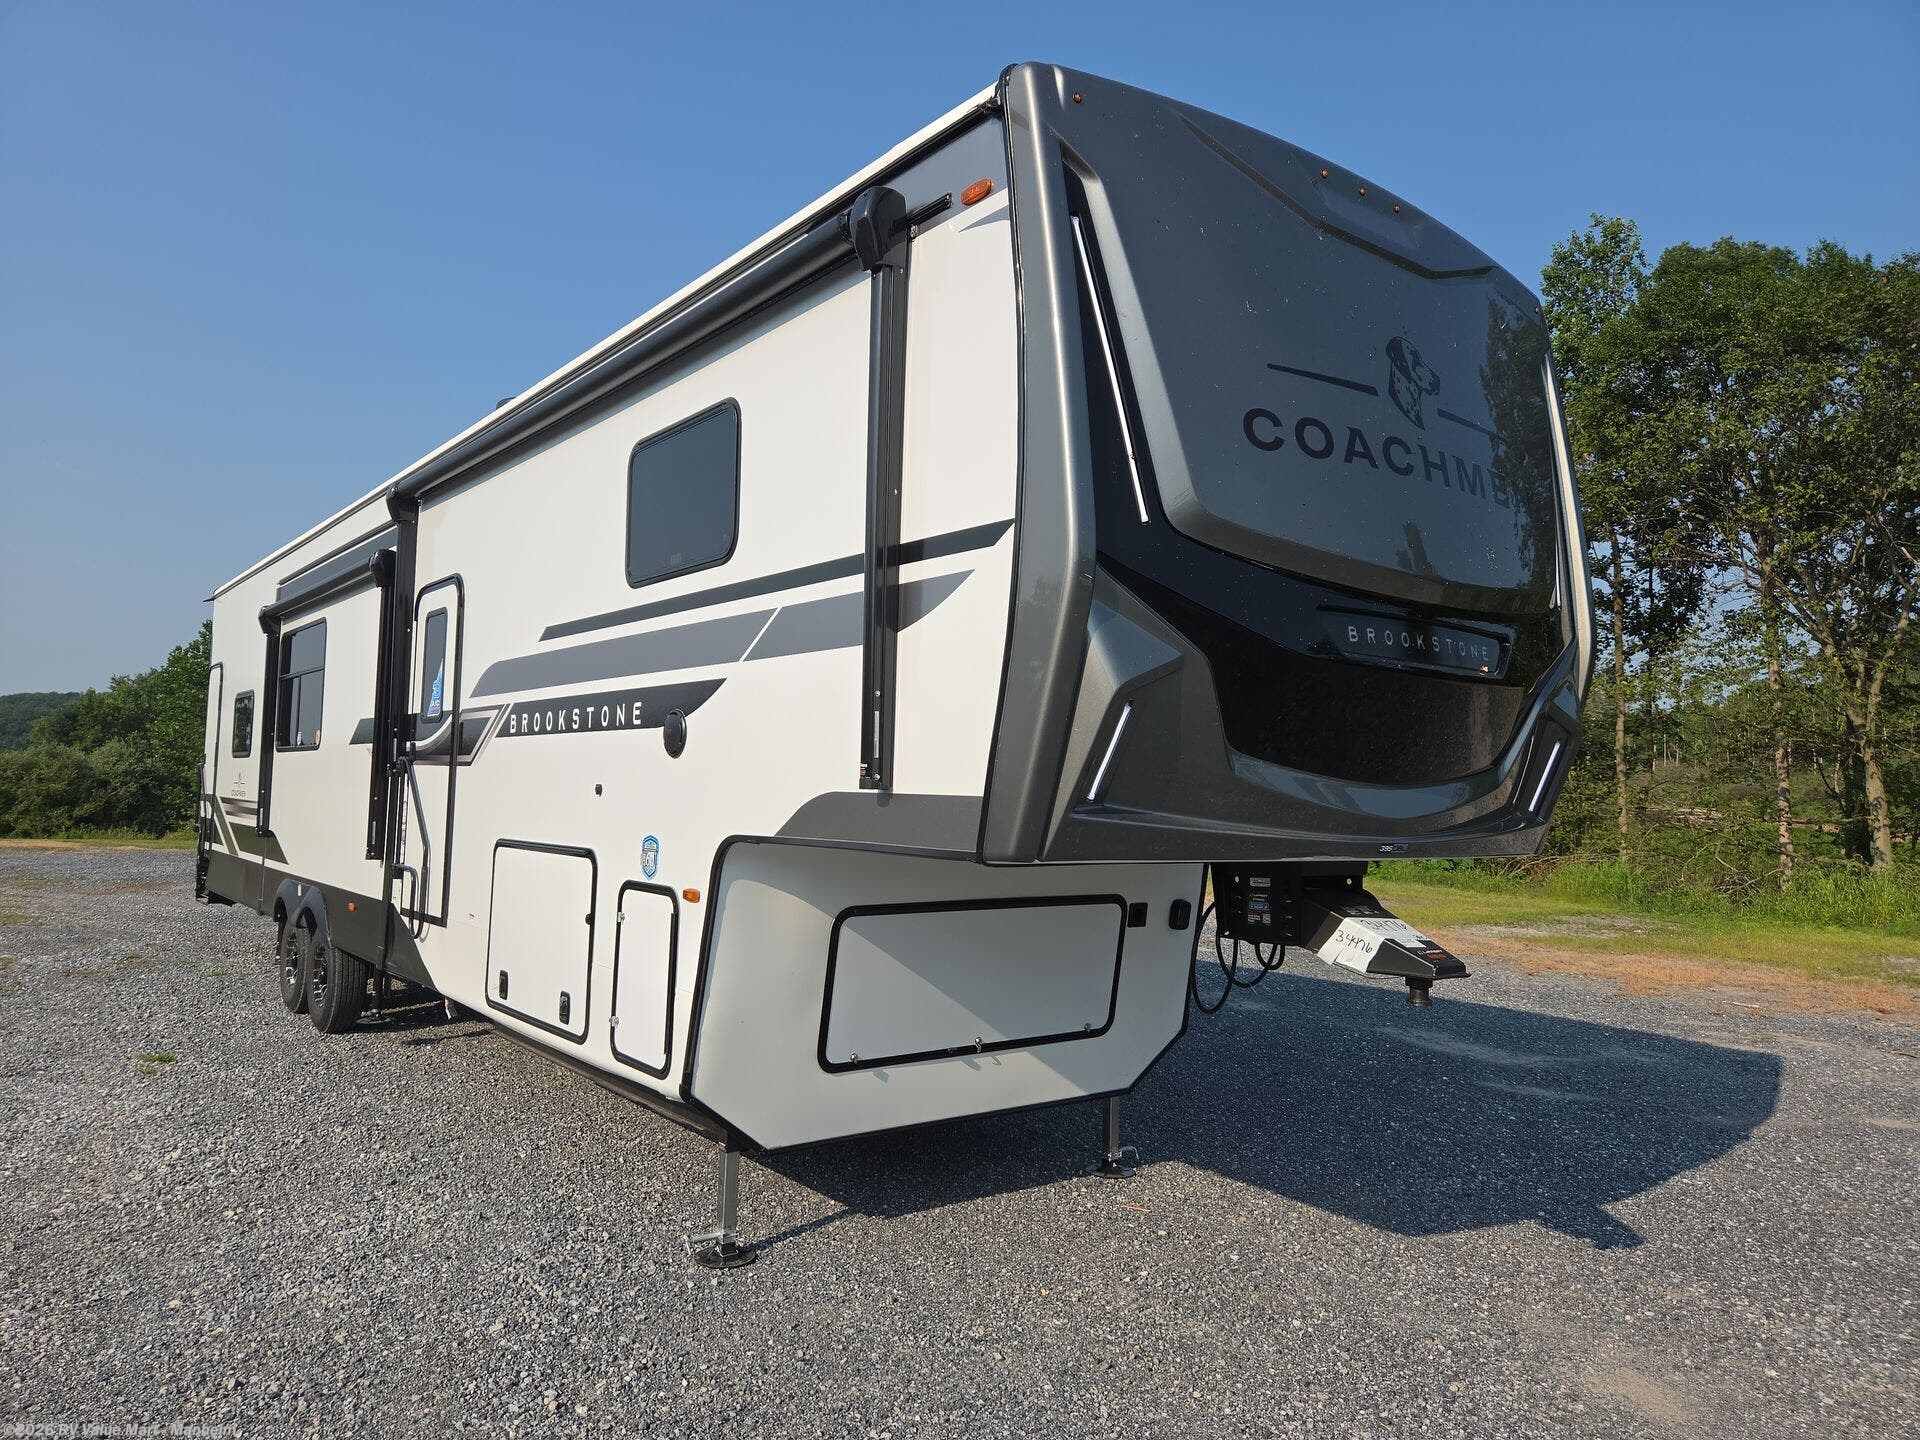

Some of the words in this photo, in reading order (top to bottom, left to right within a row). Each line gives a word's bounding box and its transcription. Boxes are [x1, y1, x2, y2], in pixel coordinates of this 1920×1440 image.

[1242, 407, 1513, 509] COACHME
[1347, 625, 1489, 661] BROOKSTONE
[509, 702, 642, 733] BROOKSTONE
